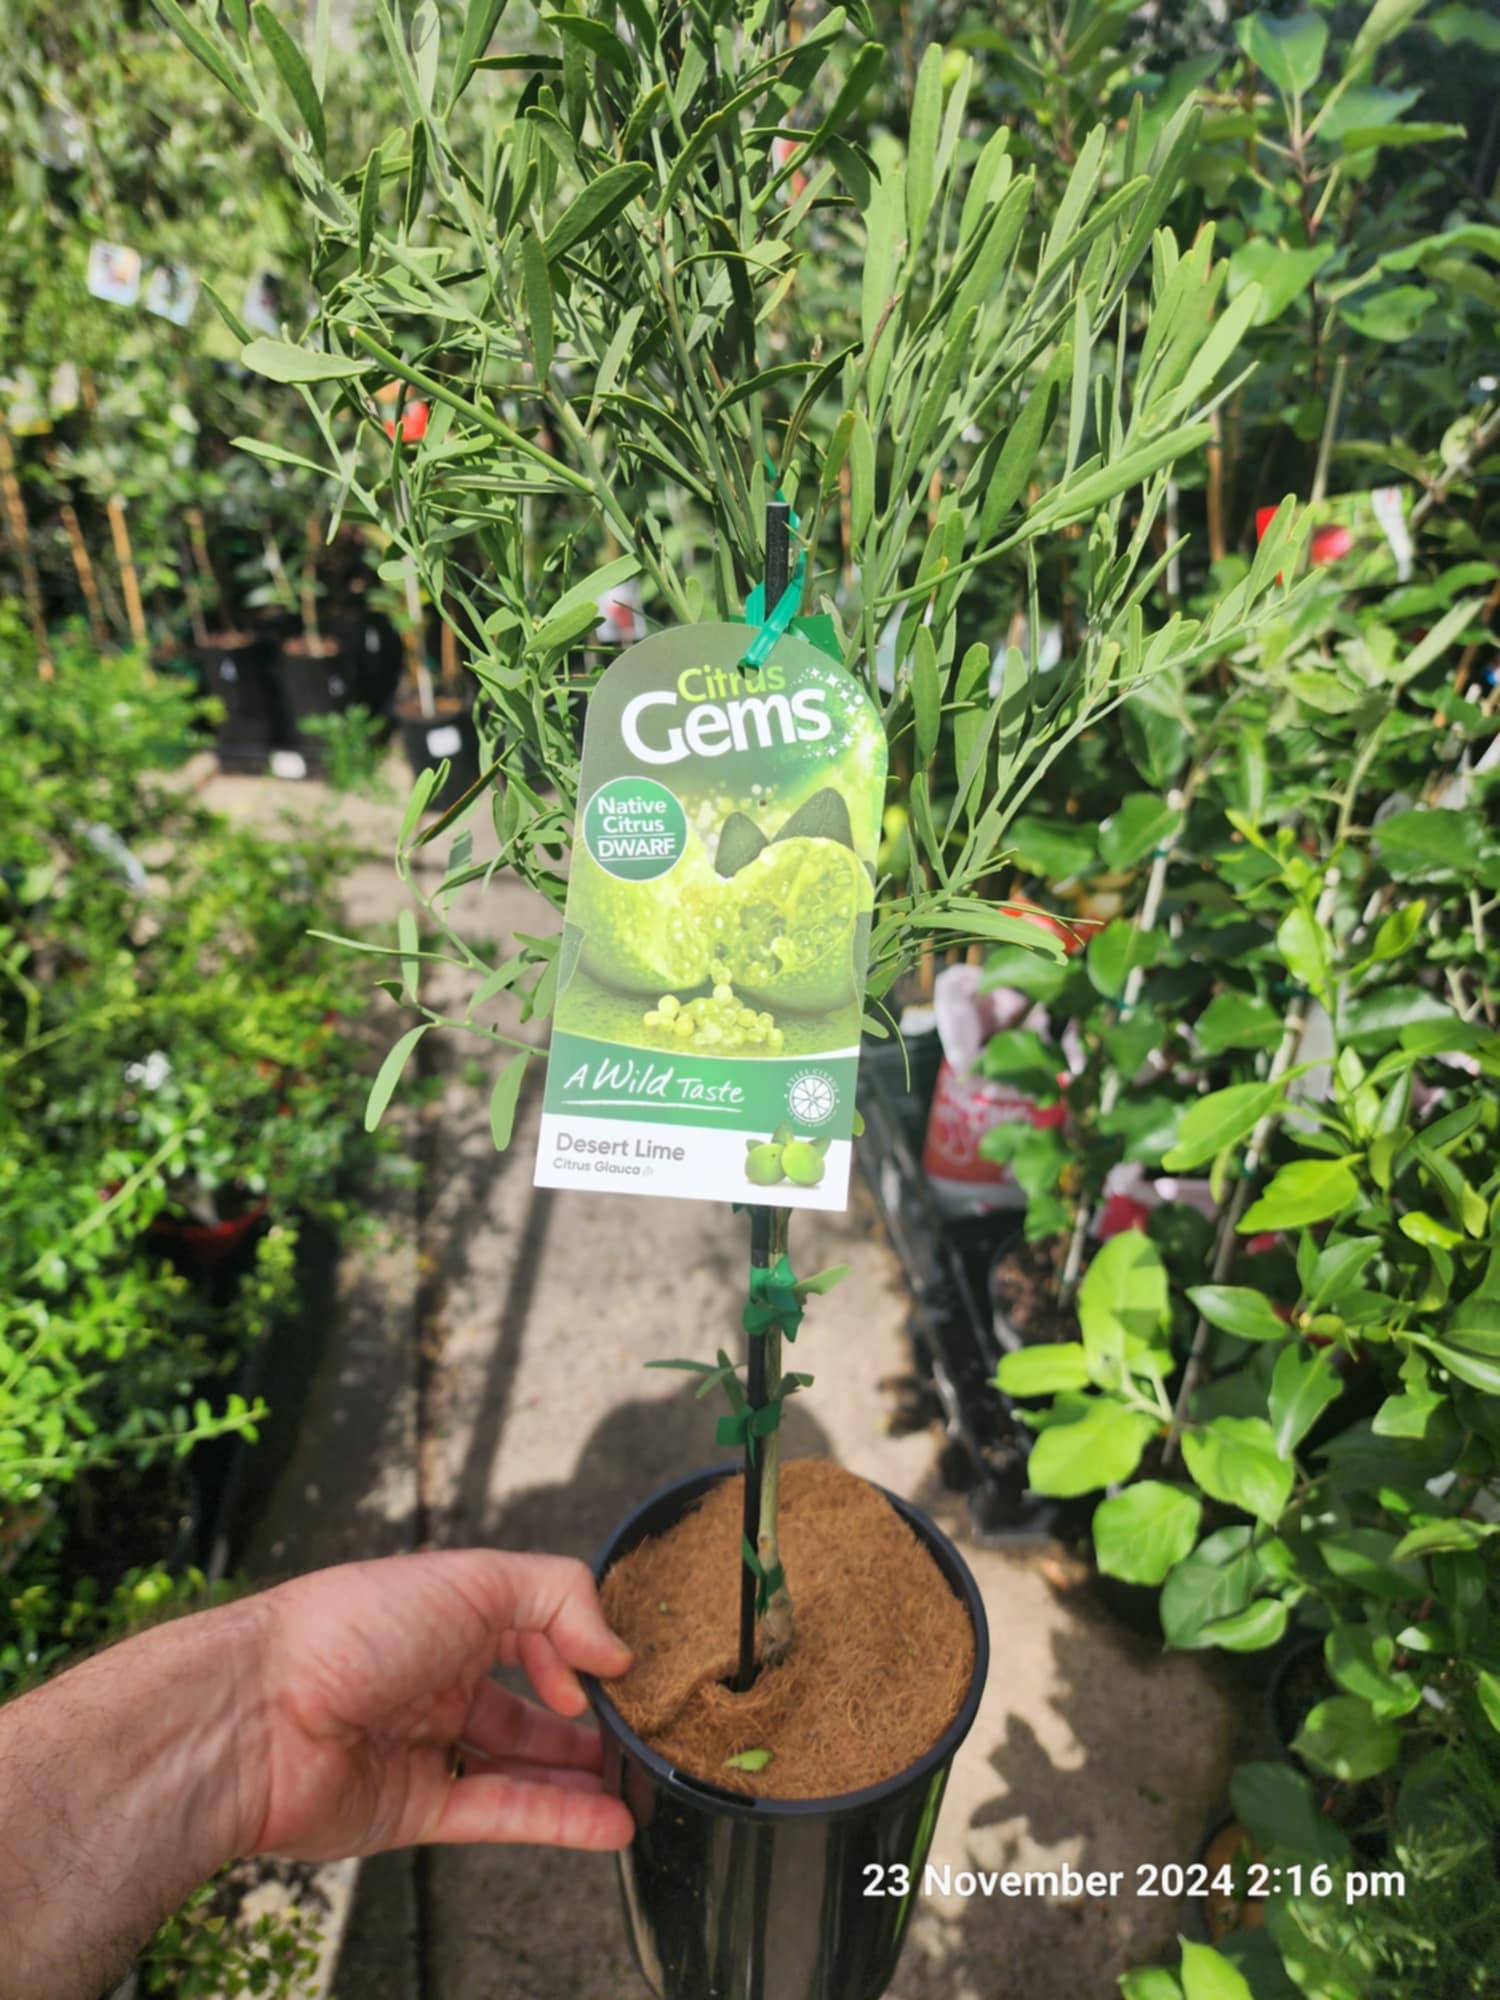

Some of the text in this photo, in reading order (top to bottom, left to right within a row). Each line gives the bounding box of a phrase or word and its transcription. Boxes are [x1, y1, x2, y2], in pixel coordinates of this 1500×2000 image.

[677, 664, 786, 702] Citrus
[620, 688, 832, 764] Gems
[597, 796, 667, 814] Native
[603, 815, 665, 833] Citrus
[597, 838, 675, 857] DWARF
[563, 1057, 745, 1103] A Wild Taste
[556, 1131, 686, 1161] Desert Lime
[553, 1157, 641, 1175] Citrus Glauca
